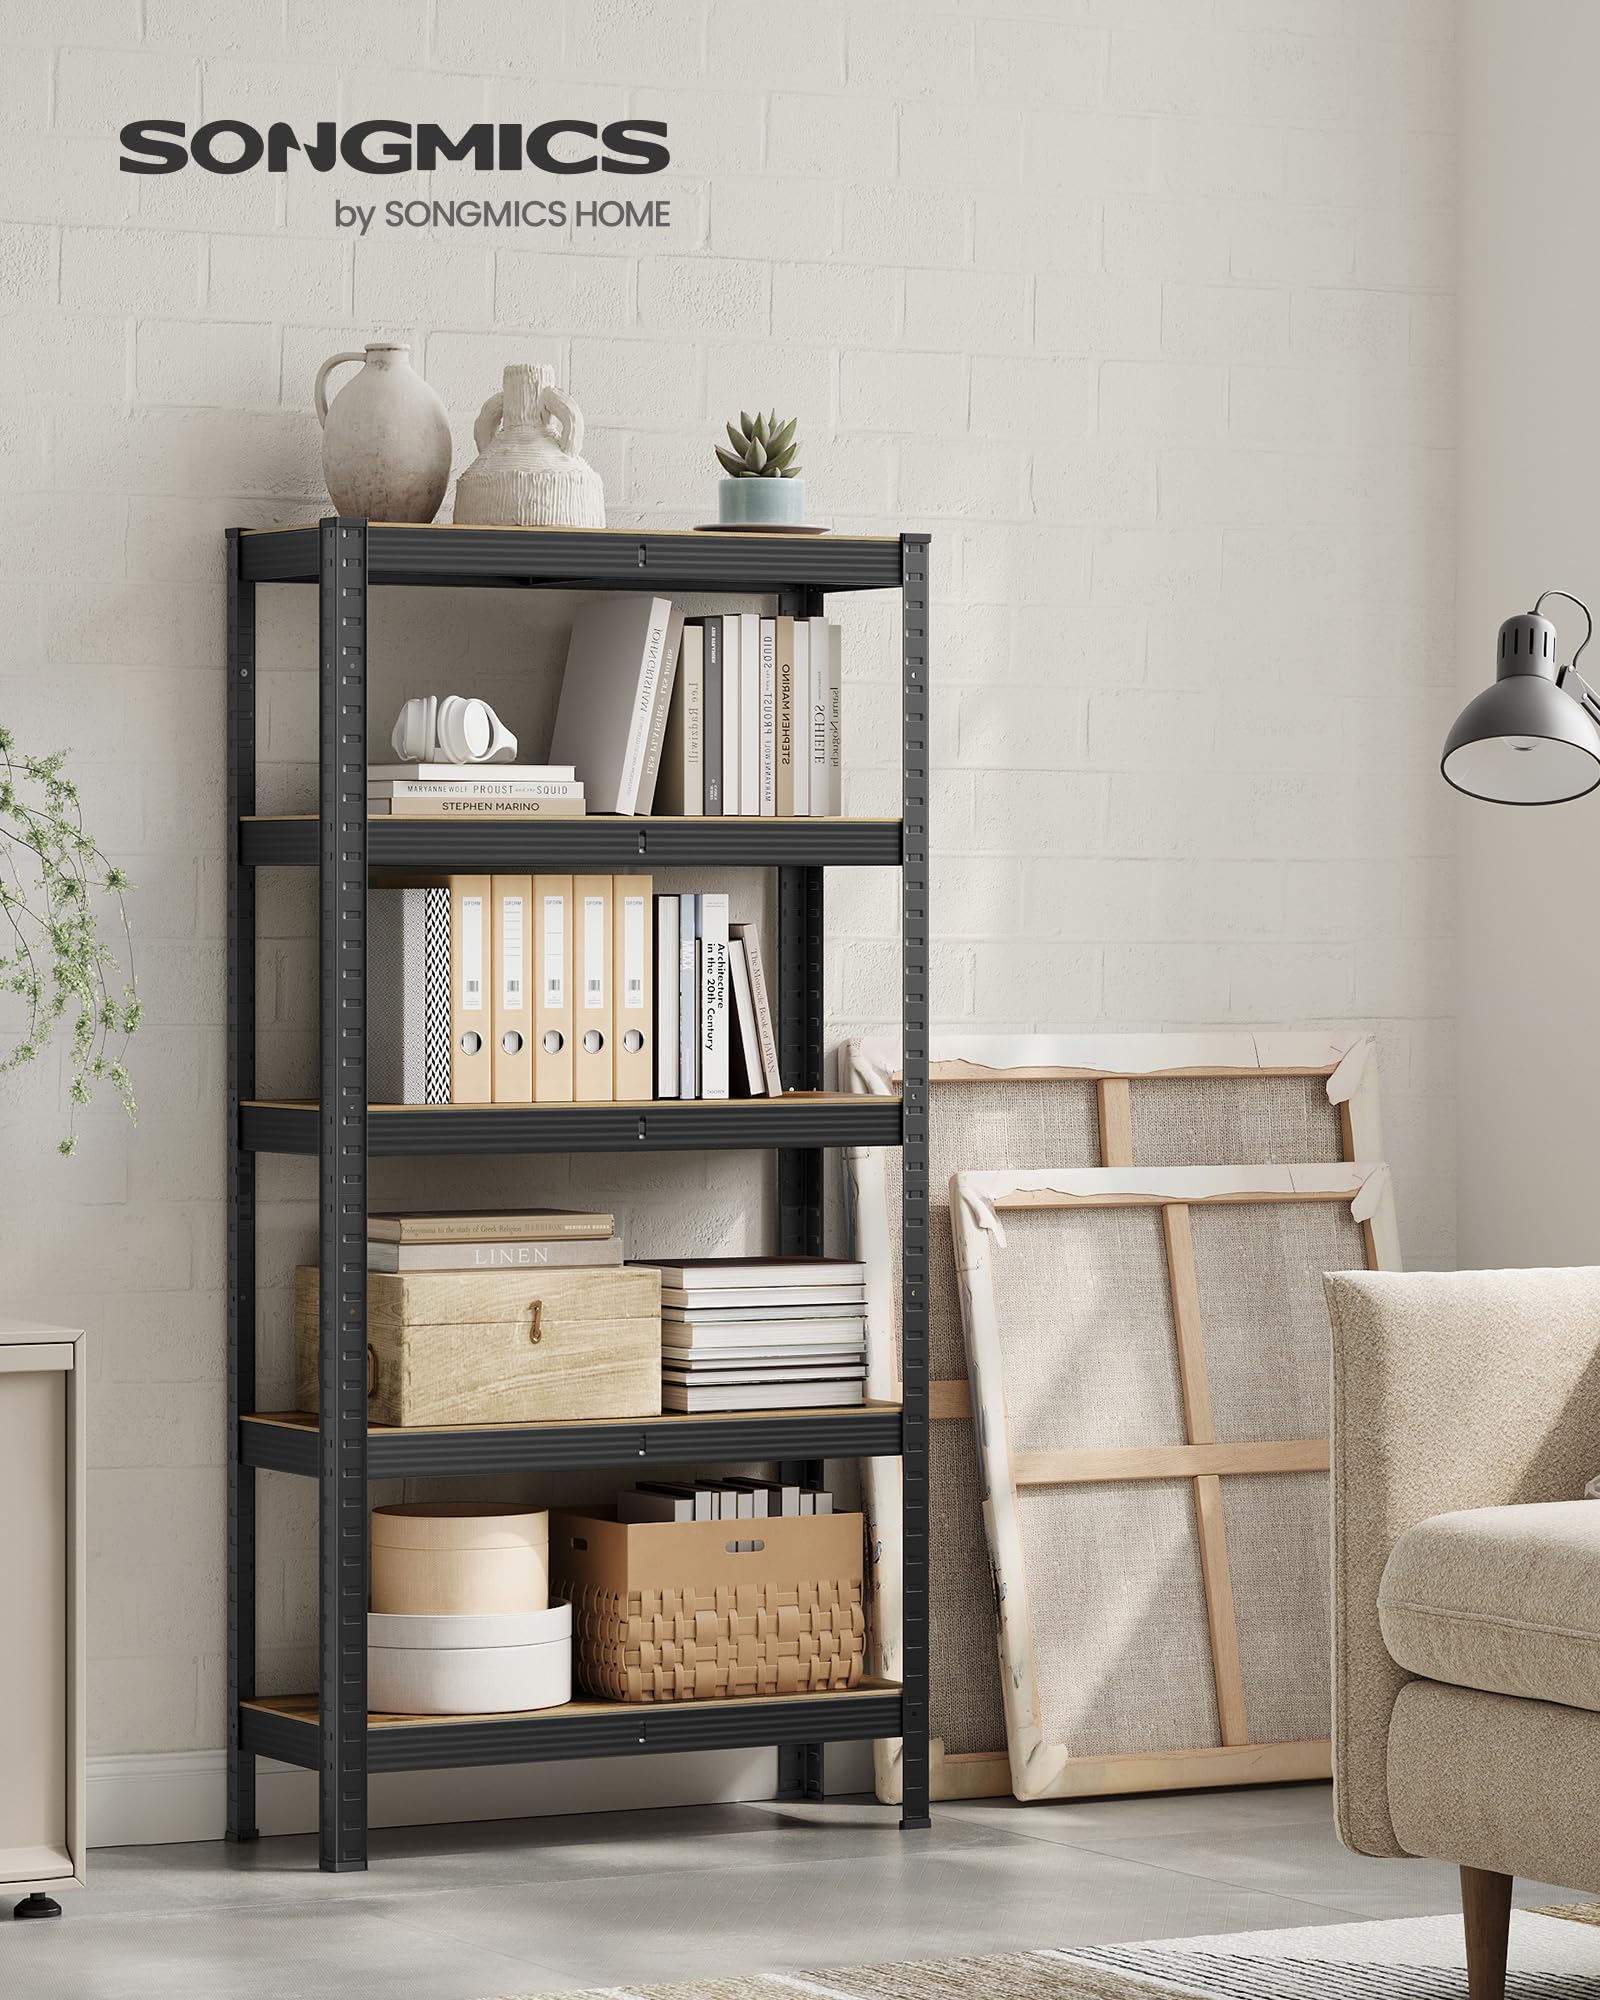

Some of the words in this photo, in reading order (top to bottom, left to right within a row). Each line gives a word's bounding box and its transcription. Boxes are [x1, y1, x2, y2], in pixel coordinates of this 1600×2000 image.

[407, 785, 447, 793] MARYANNE
[473, 785, 514, 794] PROUST
[536, 785, 568, 795] SQUID
[442, 802, 493, 811] STEPHEN
[495, 802, 540, 811] MARINO
[707, 943, 716, 953] in
[750, 949, 759, 966] The
[707, 957, 716, 974] the
[717, 943, 726, 1009] Architecture
[707, 978, 716, 1004] 20th
[753, 966, 764, 1006] Monocle
[705, 1008, 716, 1051] Century
[759, 1007, 769, 1032] Book
[764, 1042, 776, 1074] JAPAN
[475, 1247, 549, 1265] LINEN
